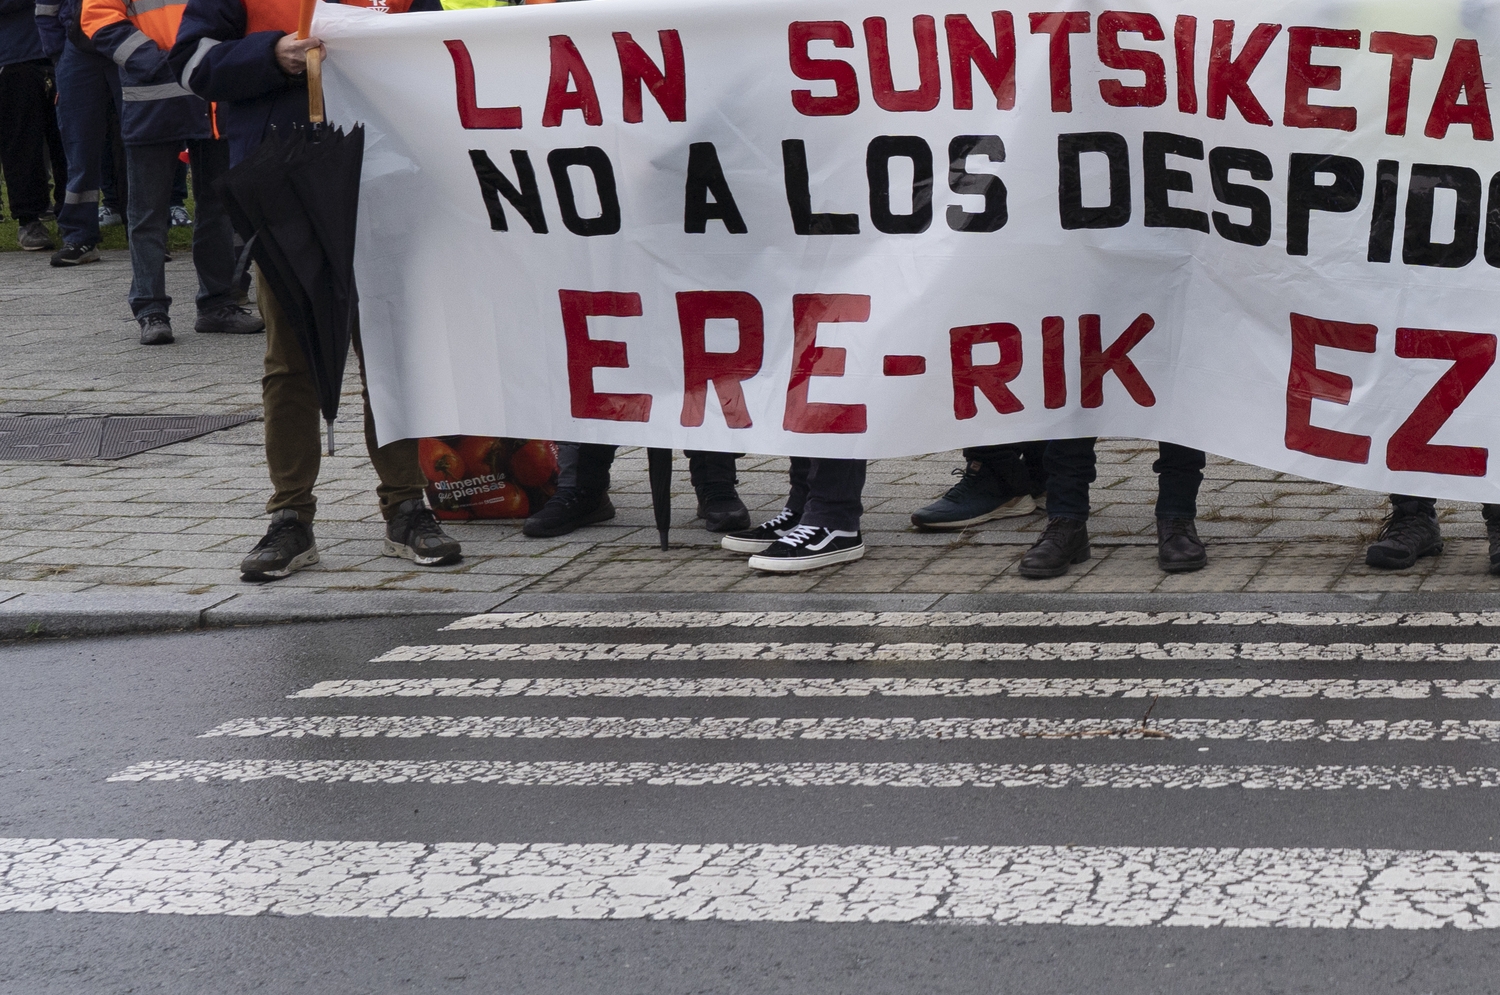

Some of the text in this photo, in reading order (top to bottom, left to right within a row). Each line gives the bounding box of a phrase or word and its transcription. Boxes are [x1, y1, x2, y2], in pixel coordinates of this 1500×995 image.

[443, 29, 686, 129] LAN
[468, 145, 621, 237] NO
[684, 141, 748, 234] A
[782, 134, 1008, 236] LOS
[558, 289, 1498, 478] ERE-RIK EZ
[434, 473, 496, 490] alimenta
[452, 481, 506, 501] piensas
